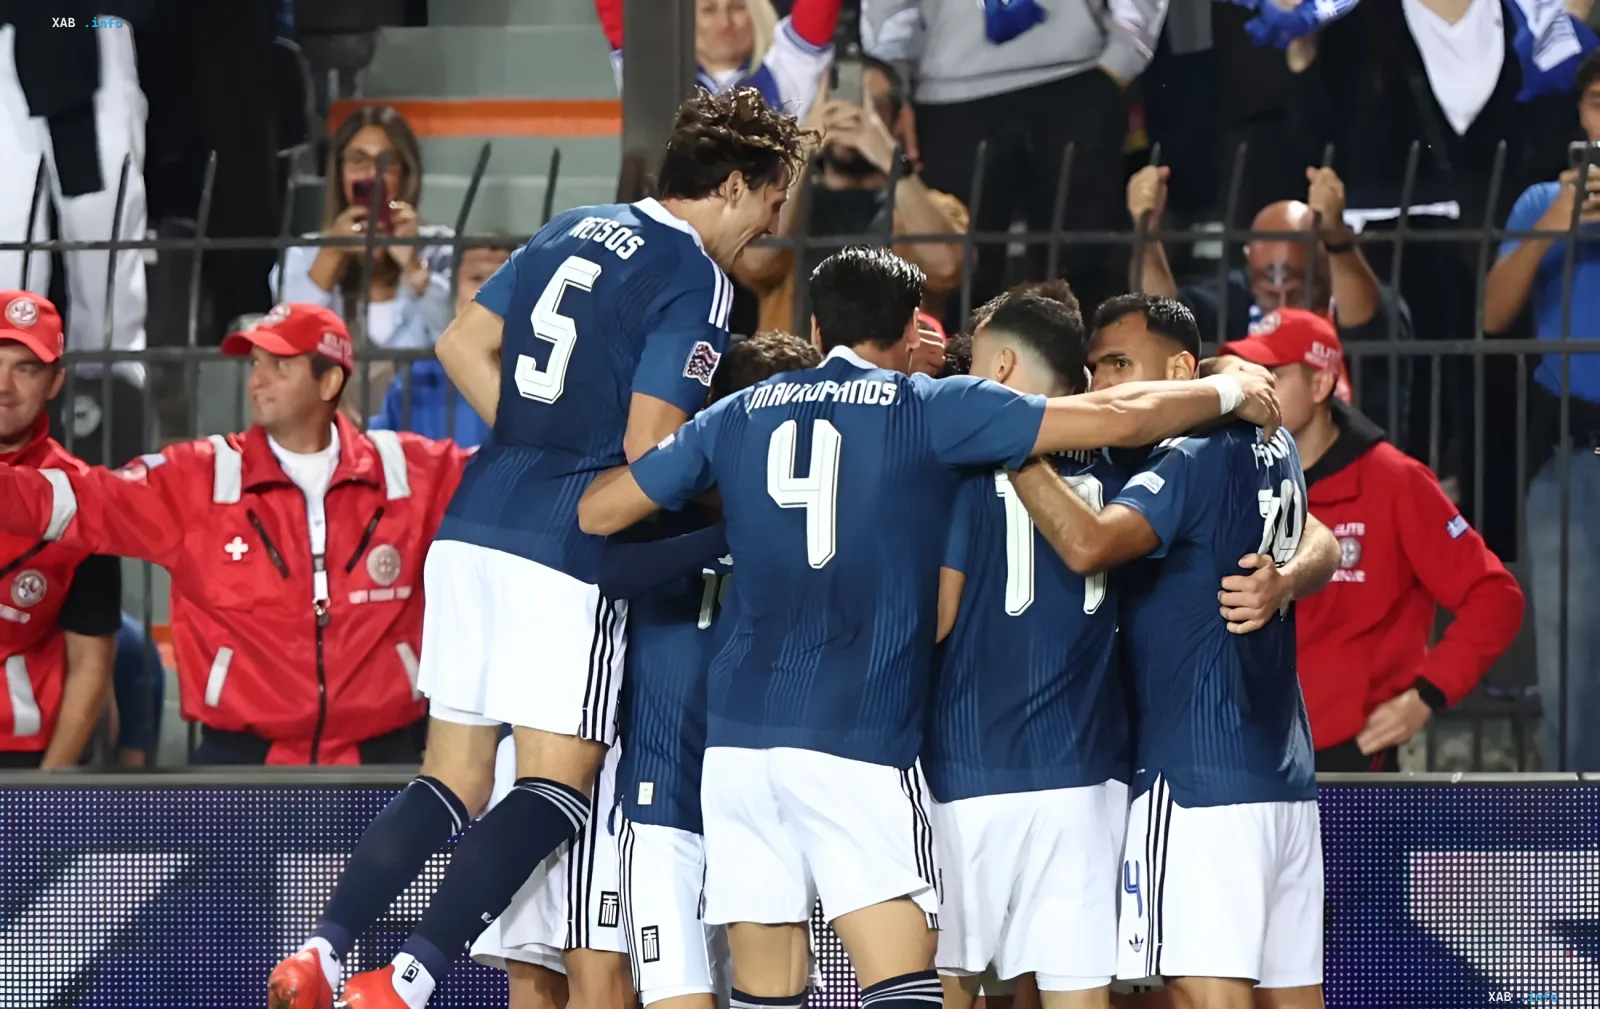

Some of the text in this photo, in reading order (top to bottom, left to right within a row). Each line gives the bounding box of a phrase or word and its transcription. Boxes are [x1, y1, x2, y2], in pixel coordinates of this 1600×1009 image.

[568, 216, 645, 260] RETSOS
[514, 255, 602, 405] 5
[746, 379, 898, 413] MAVROPANOS
[767, 418, 842, 569] 4
